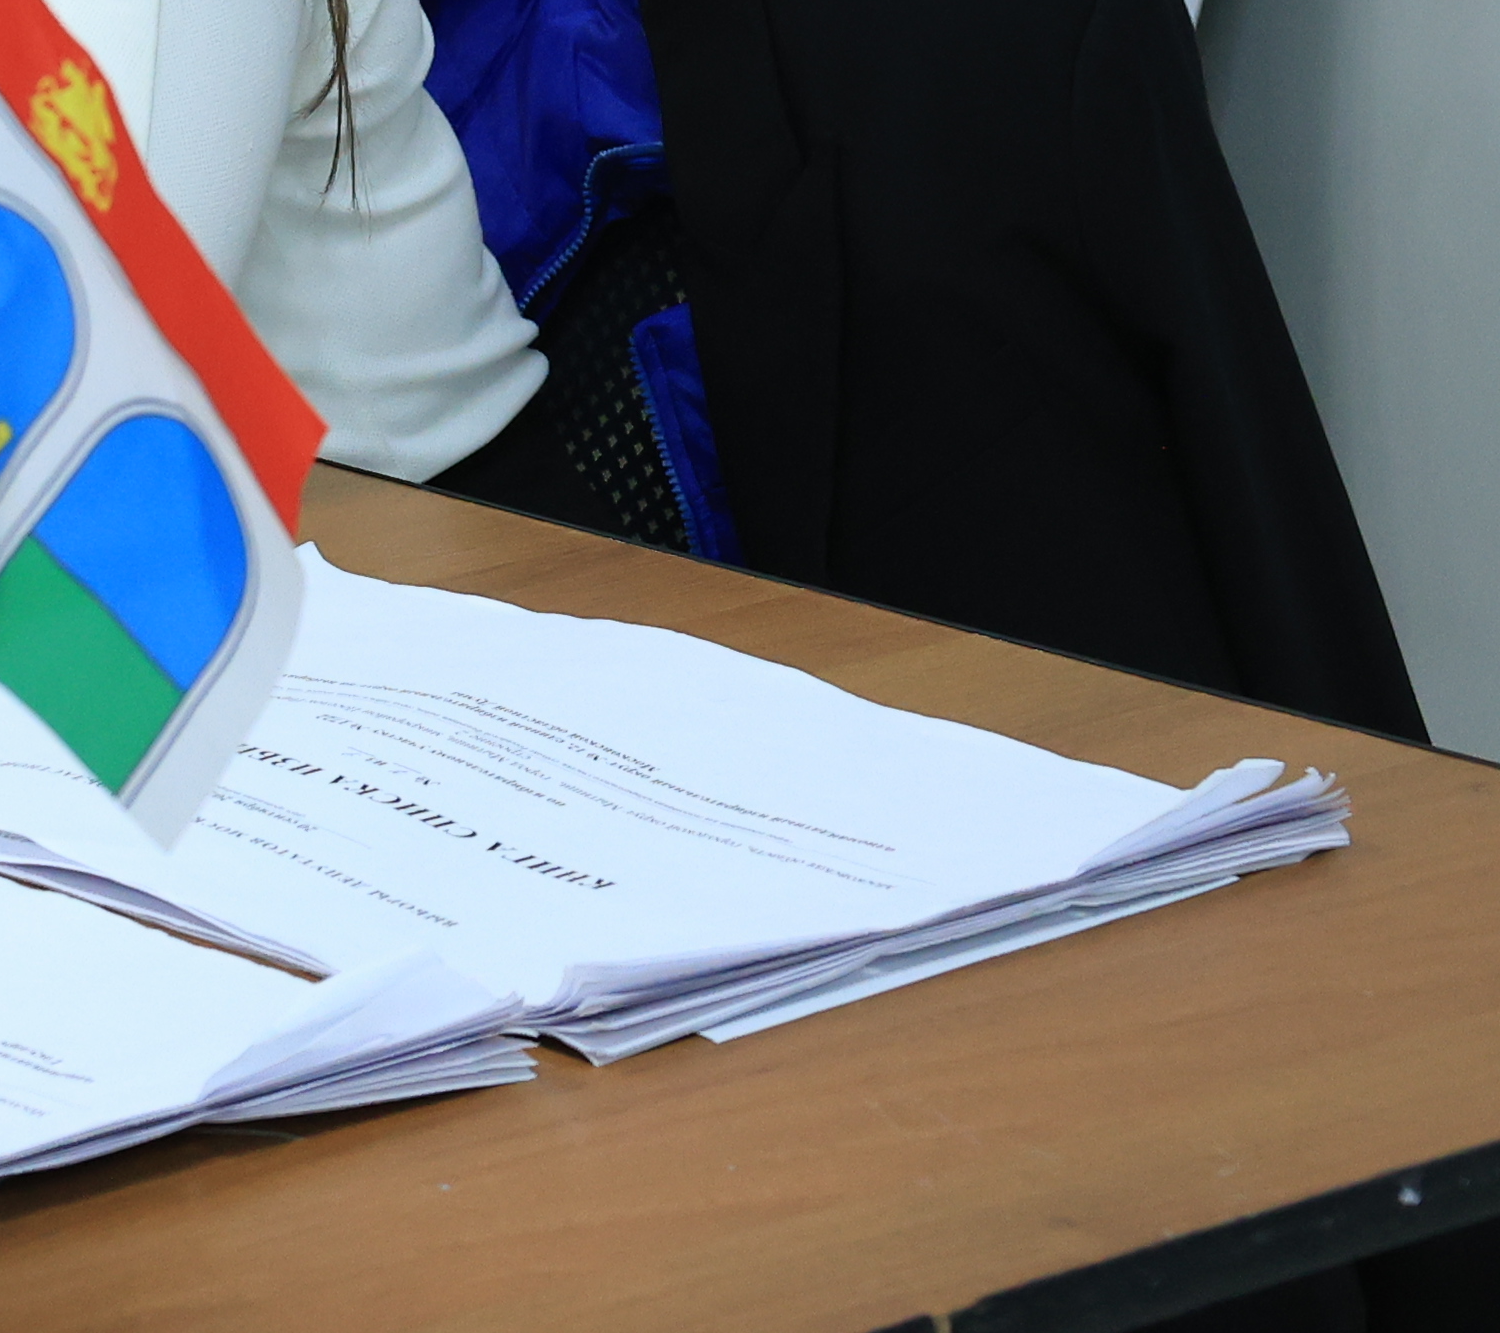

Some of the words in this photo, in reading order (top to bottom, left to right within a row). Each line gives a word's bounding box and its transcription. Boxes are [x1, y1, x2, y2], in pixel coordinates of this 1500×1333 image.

[343, 722, 370, 731] №
[492, 706, 568, 733] областной
[373, 730, 431, 750] участку
[568, 733, 655, 772] Московской
[365, 758, 387, 766] из
[429, 750, 545, 798] избирательному
[415, 776, 440, 786] №
[234, 800, 299, 824] сентября
[330, 775, 477, 838] СПИСКА
[546, 798, 566, 806] по
[650, 779, 768, 818] избирательный
[297, 824, 318, 832] 20
[250, 838, 366, 888] ДЕПУТАТОВ
[487, 842, 614, 889] КНИГА
[368, 890, 458, 927] ВЫБОРЫ
